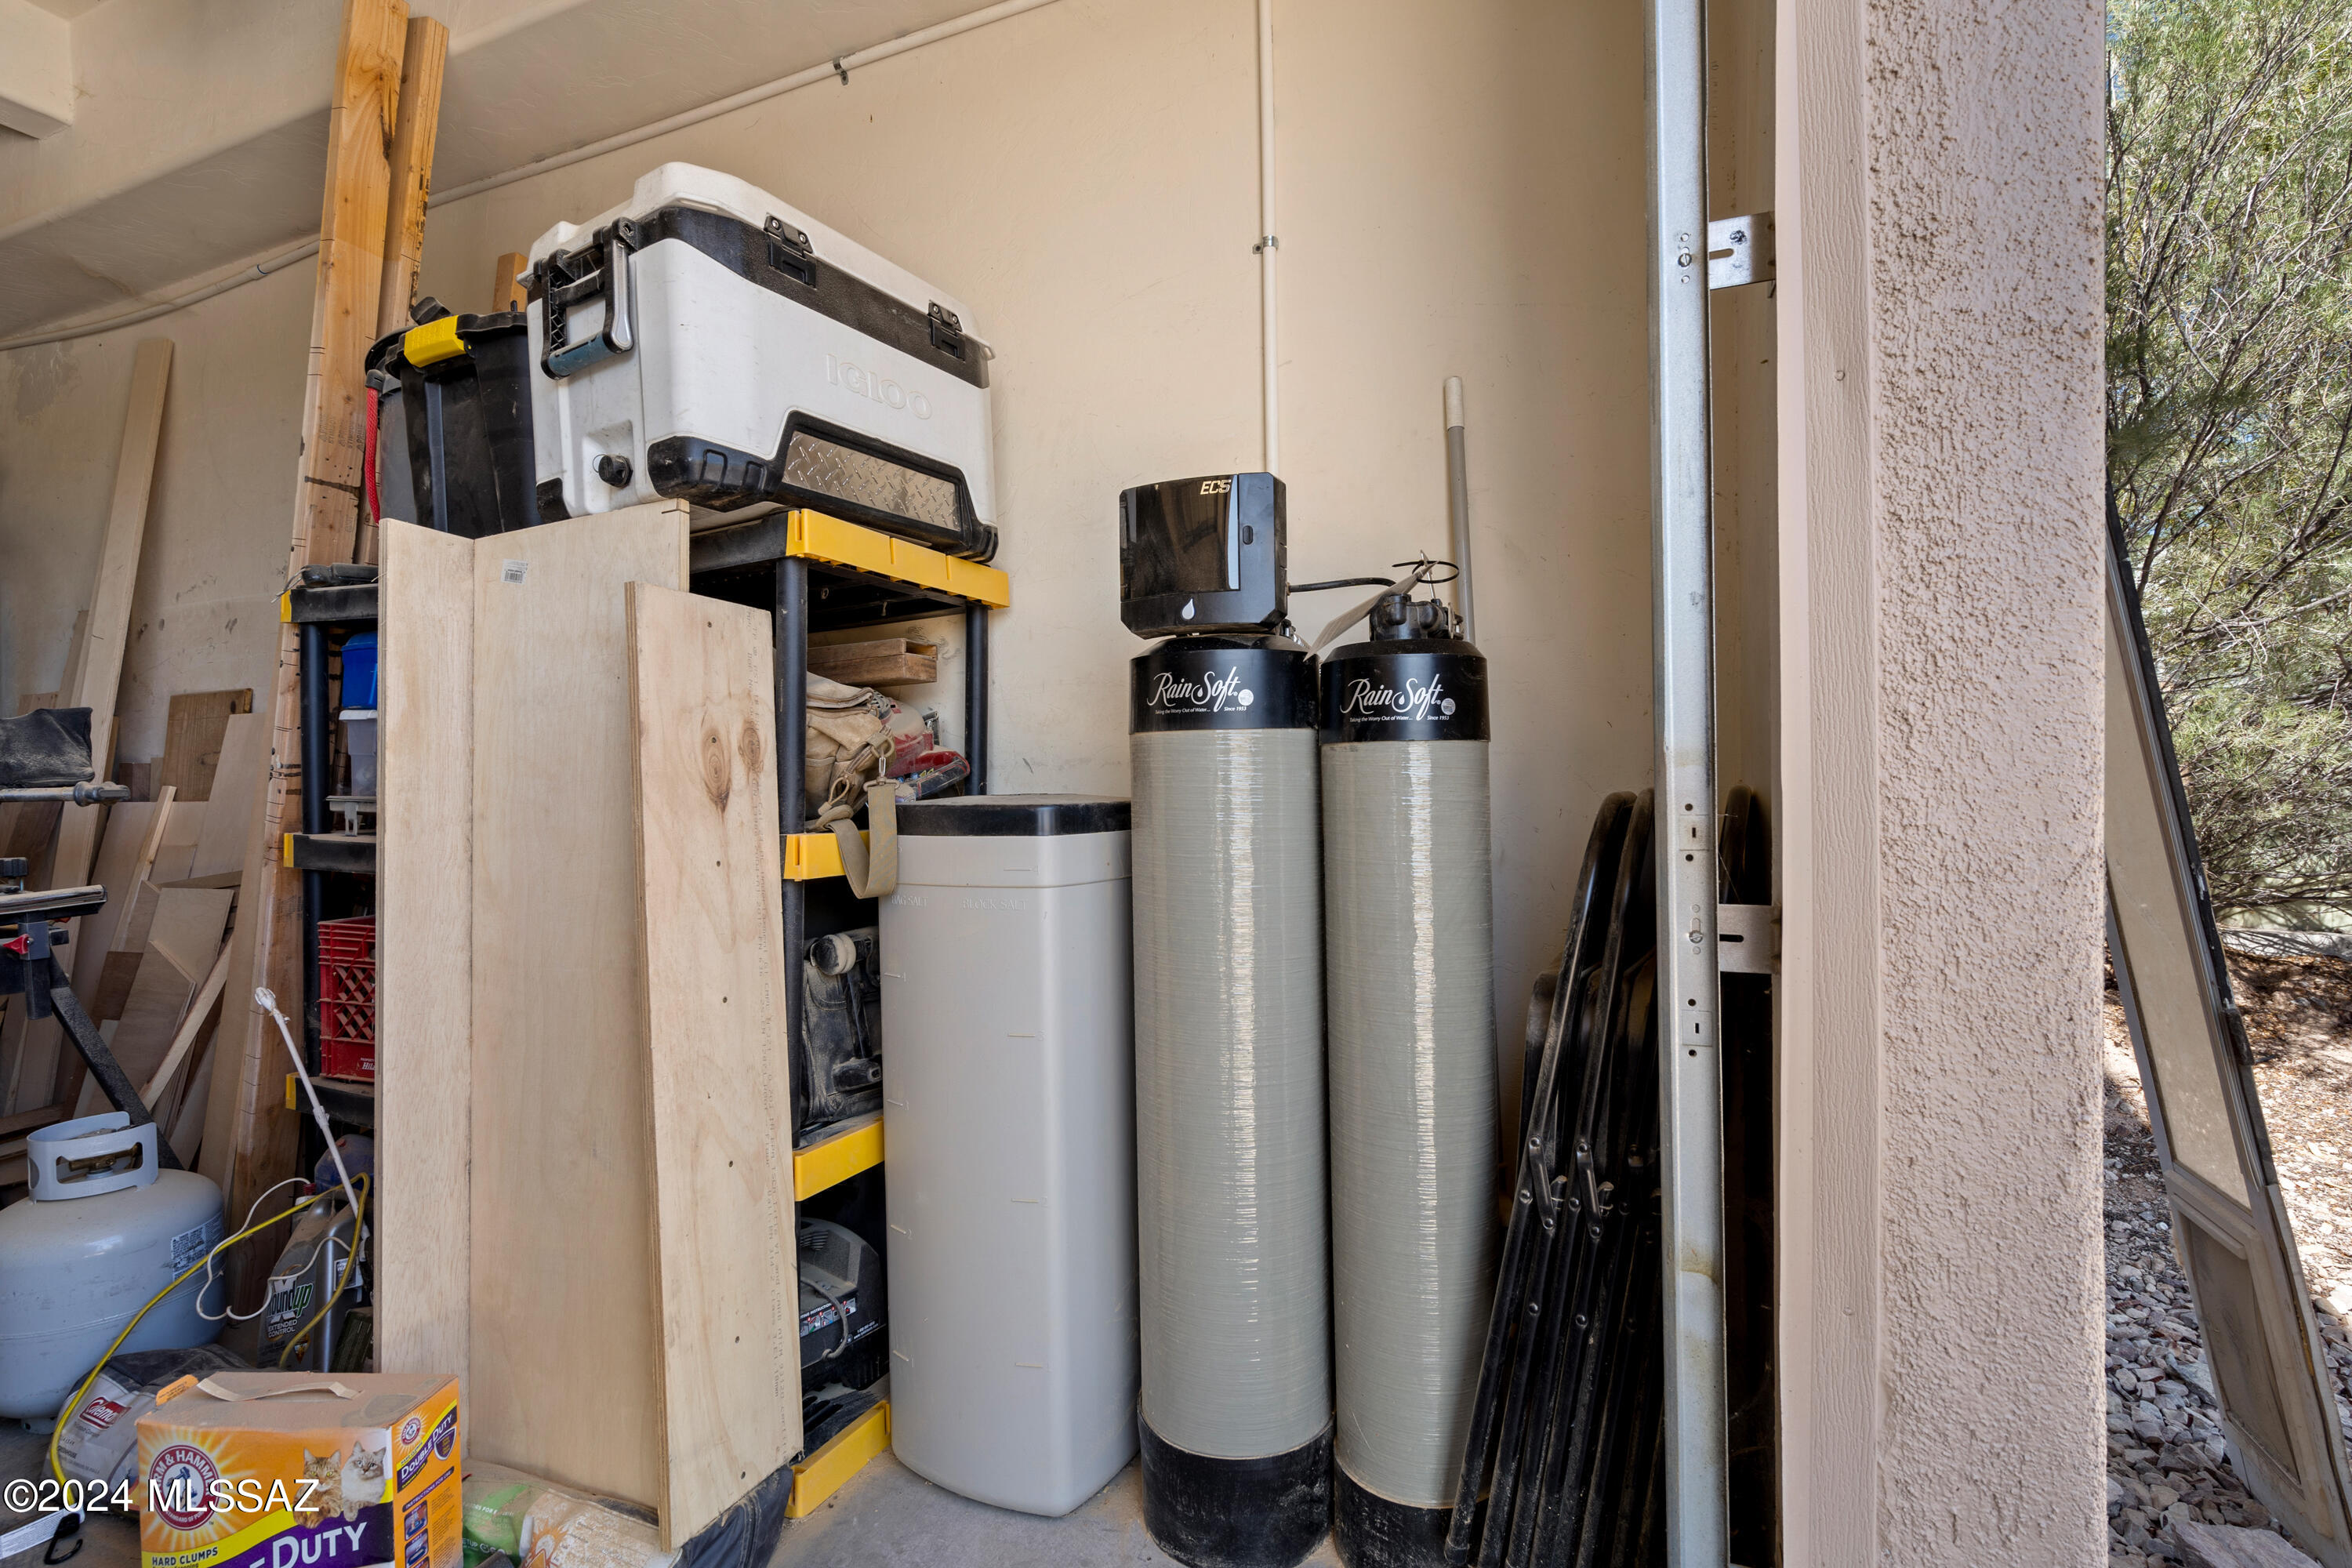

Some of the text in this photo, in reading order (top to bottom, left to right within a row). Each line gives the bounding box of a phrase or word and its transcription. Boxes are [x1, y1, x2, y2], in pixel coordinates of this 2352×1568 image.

[826, 353, 933, 420] IGLOO
[892, 895, 928, 907] BAG SALT
[963, 897, 1029, 910] BLOCK SALT
[268, 1319, 298, 1332] EXTENDED
[268, 1327, 296, 1338] CONTROL
[165, 1454, 175, 1466] &
[152, 1547, 218, 1566] HARD CLUMPS
